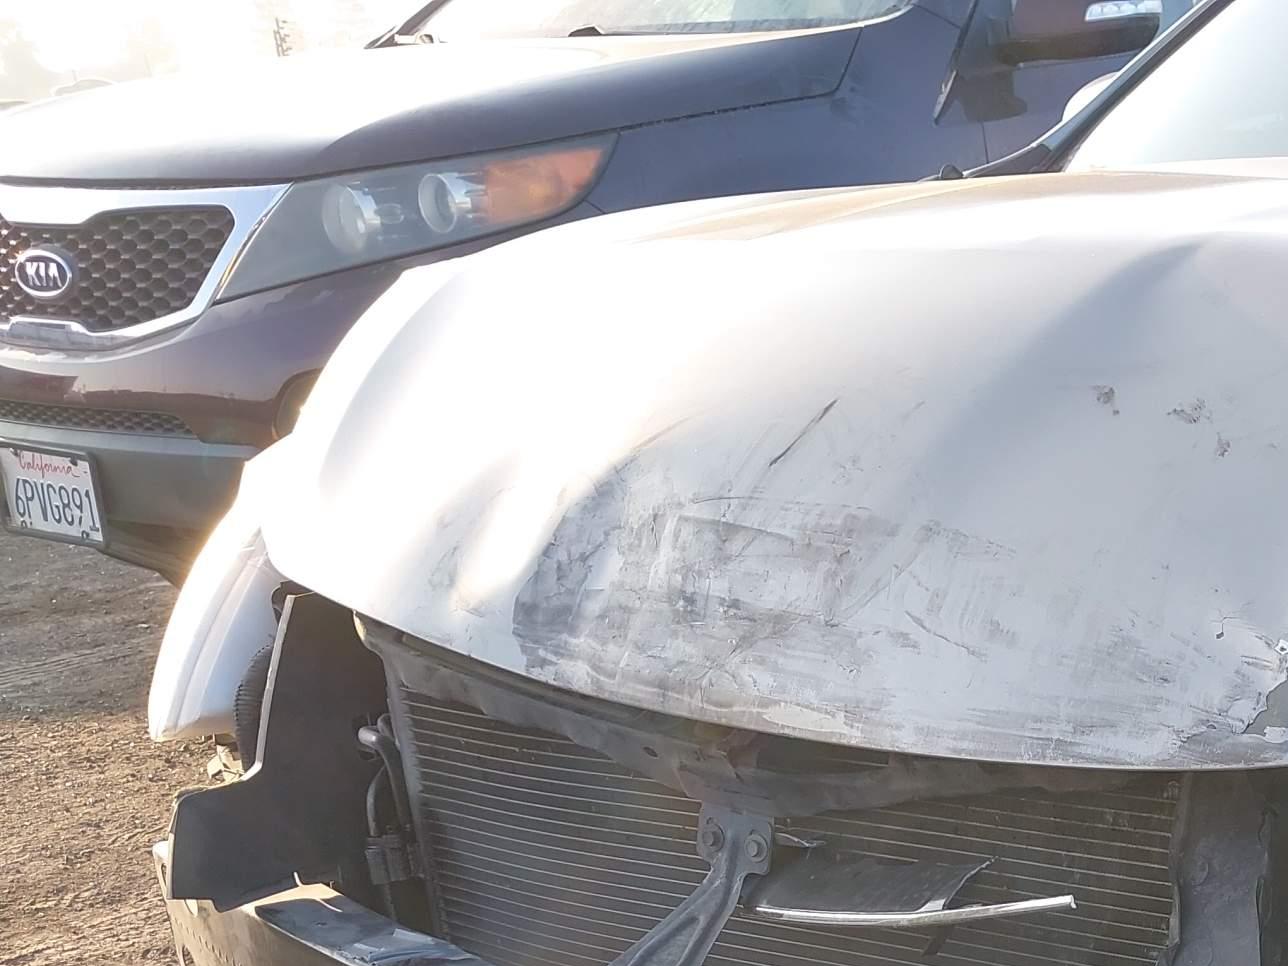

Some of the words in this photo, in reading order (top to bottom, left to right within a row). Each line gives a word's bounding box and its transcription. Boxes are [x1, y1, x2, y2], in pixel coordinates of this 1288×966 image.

[25, 261, 62, 287] KIA
[18, 453, 80, 478] California
[15, 477, 100, 532] 6PVG891
